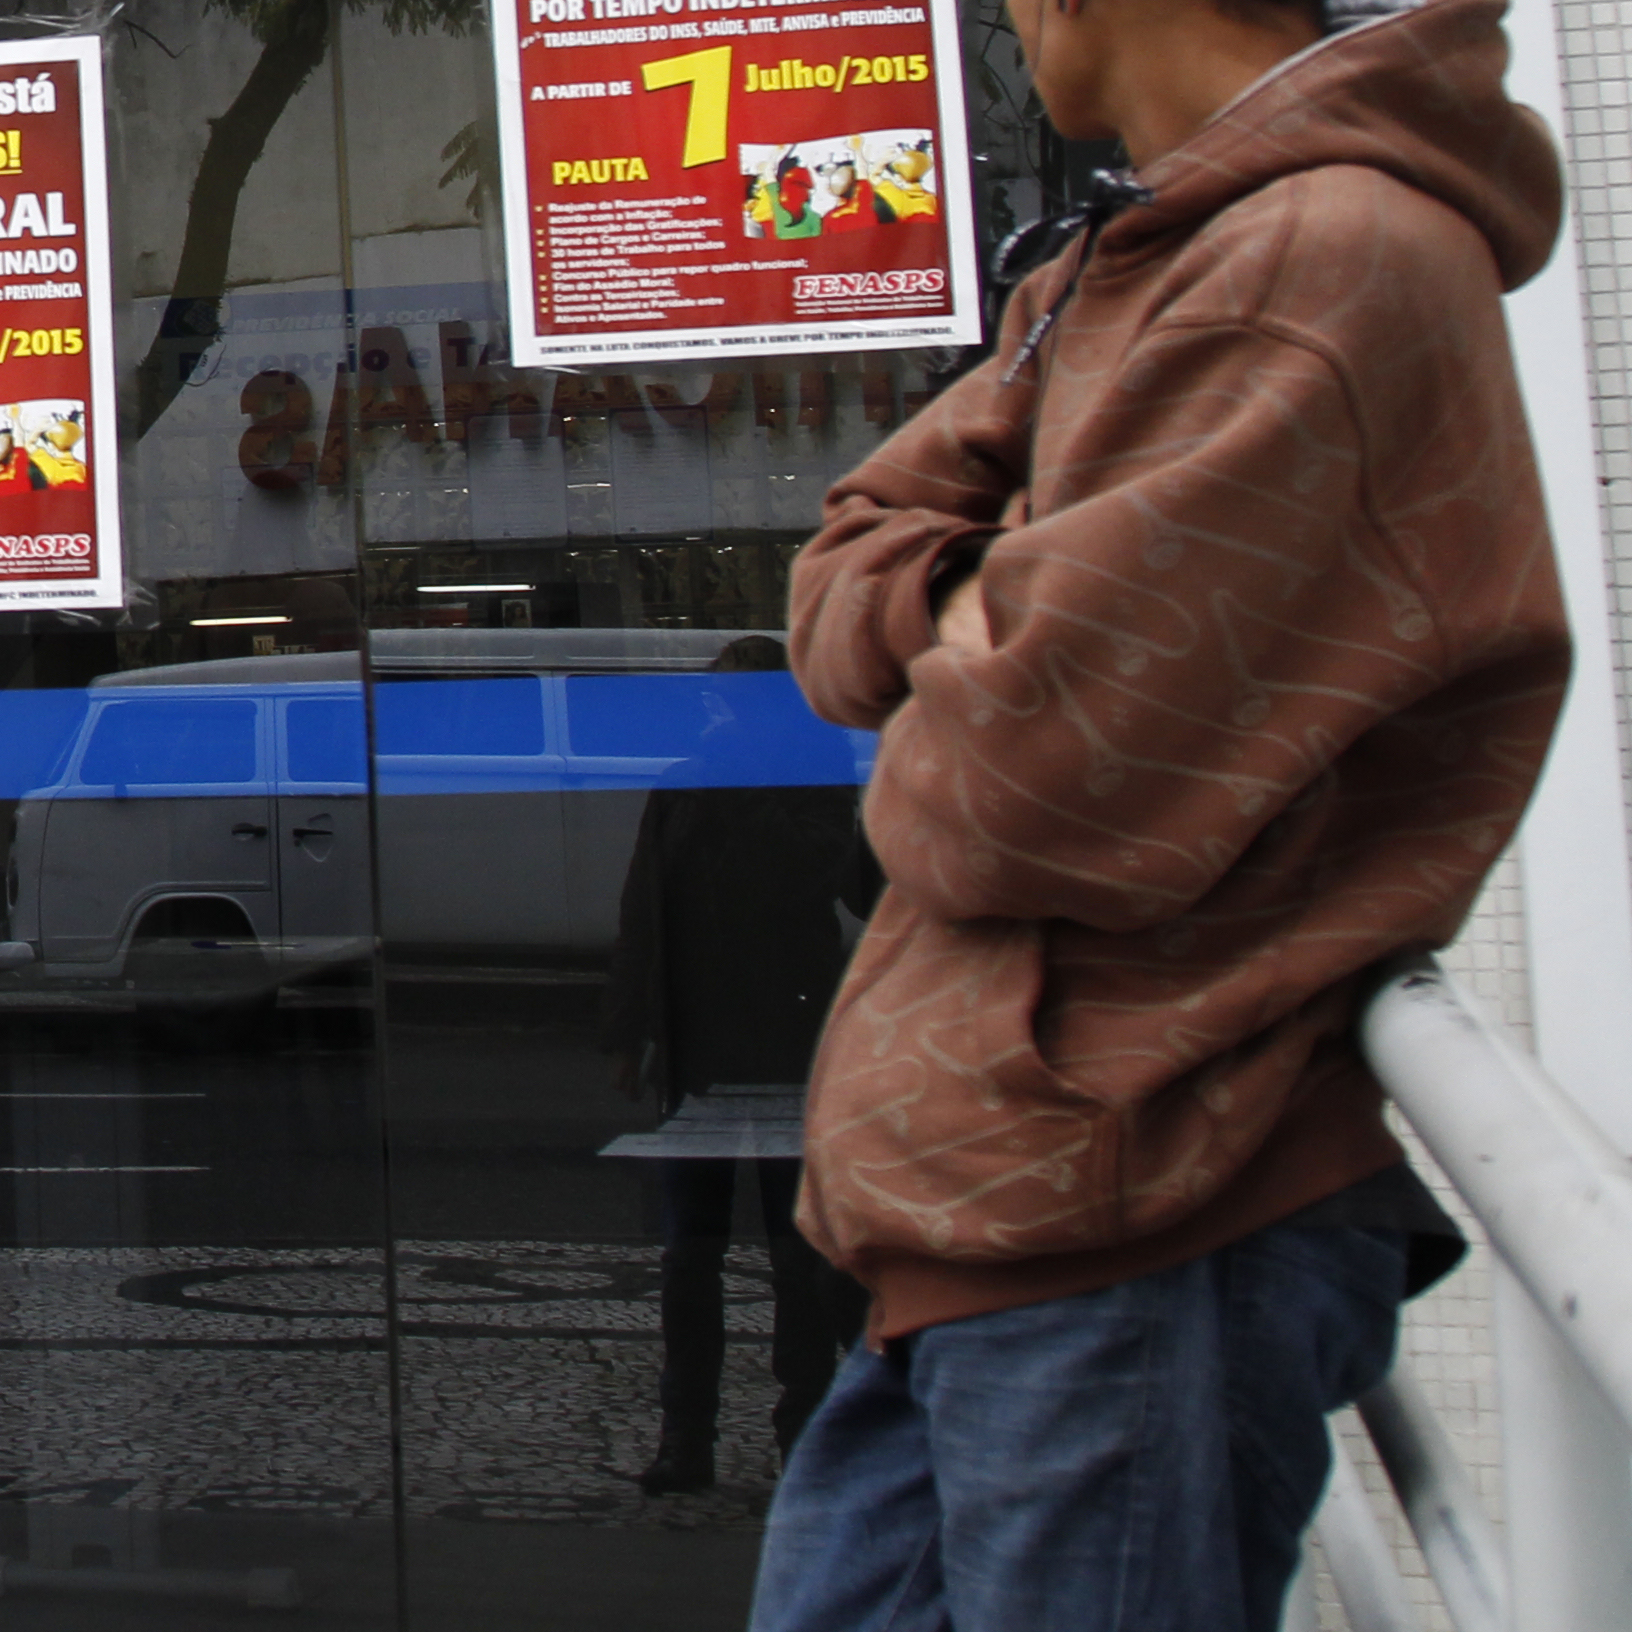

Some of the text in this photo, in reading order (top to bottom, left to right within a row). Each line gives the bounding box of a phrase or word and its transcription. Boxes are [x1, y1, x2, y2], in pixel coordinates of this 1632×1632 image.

[544, 3, 925, 47] TRABALHADORES DO INSS, SAÚDE, MTE, ANVISA e PREVIDÊNCIA
[532, 46, 928, 169] A PARTIR DE 7 Julho/2015
[553, 157, 646, 184] PAUTA
[5, 279, 81, 299] PREVIDÊNCIA
[793, 268, 944, 298] FENASPS
